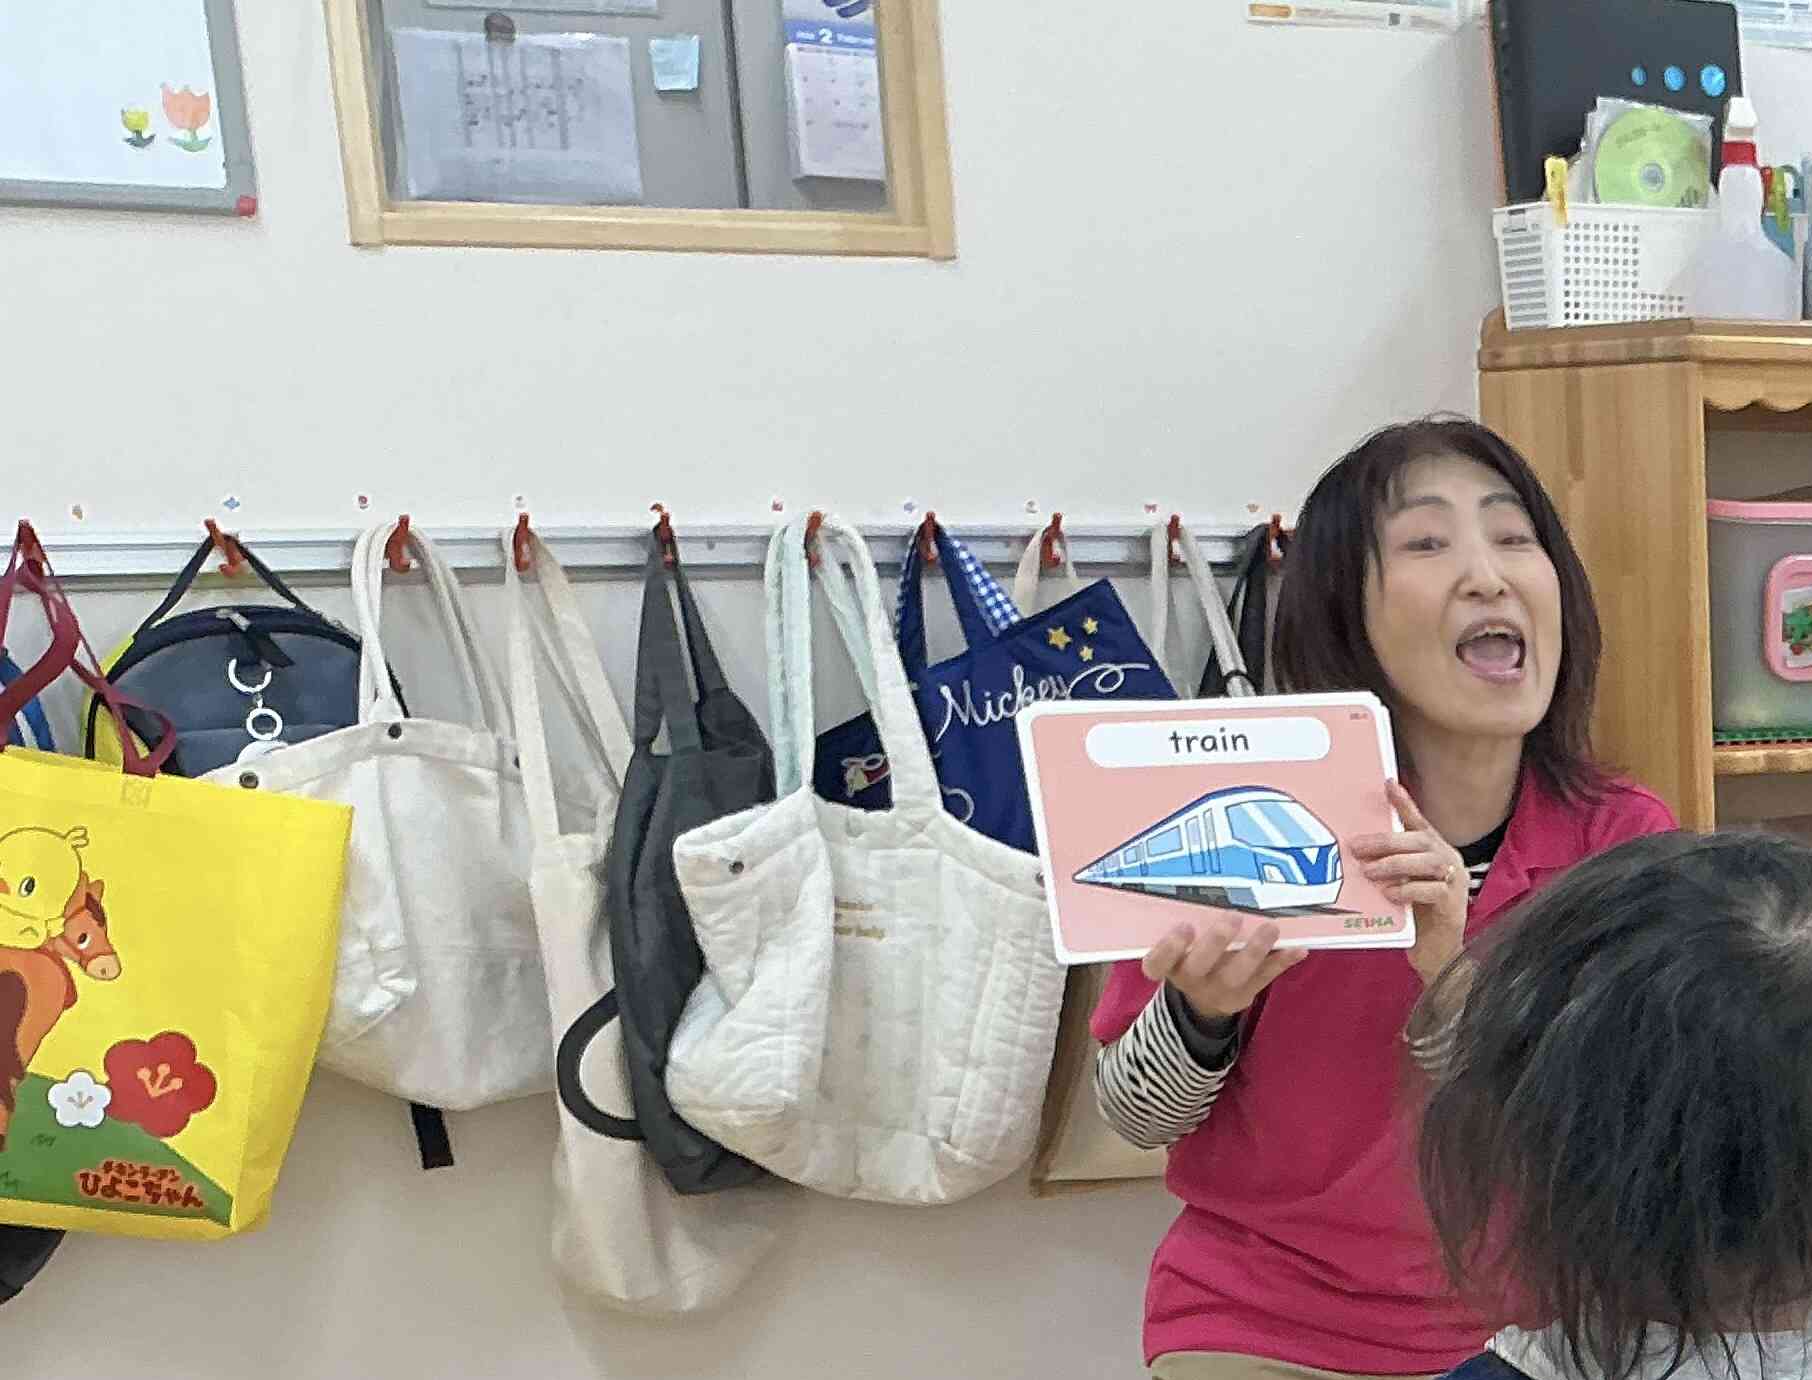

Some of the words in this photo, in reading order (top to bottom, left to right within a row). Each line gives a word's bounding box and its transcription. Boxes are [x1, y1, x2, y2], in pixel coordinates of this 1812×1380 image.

[818, 28, 833, 44] 2
[935, 664, 1149, 742] Mickey
[1168, 727, 1250, 755] train
[79, 1171, 204, 1208] ひよこちゃん
